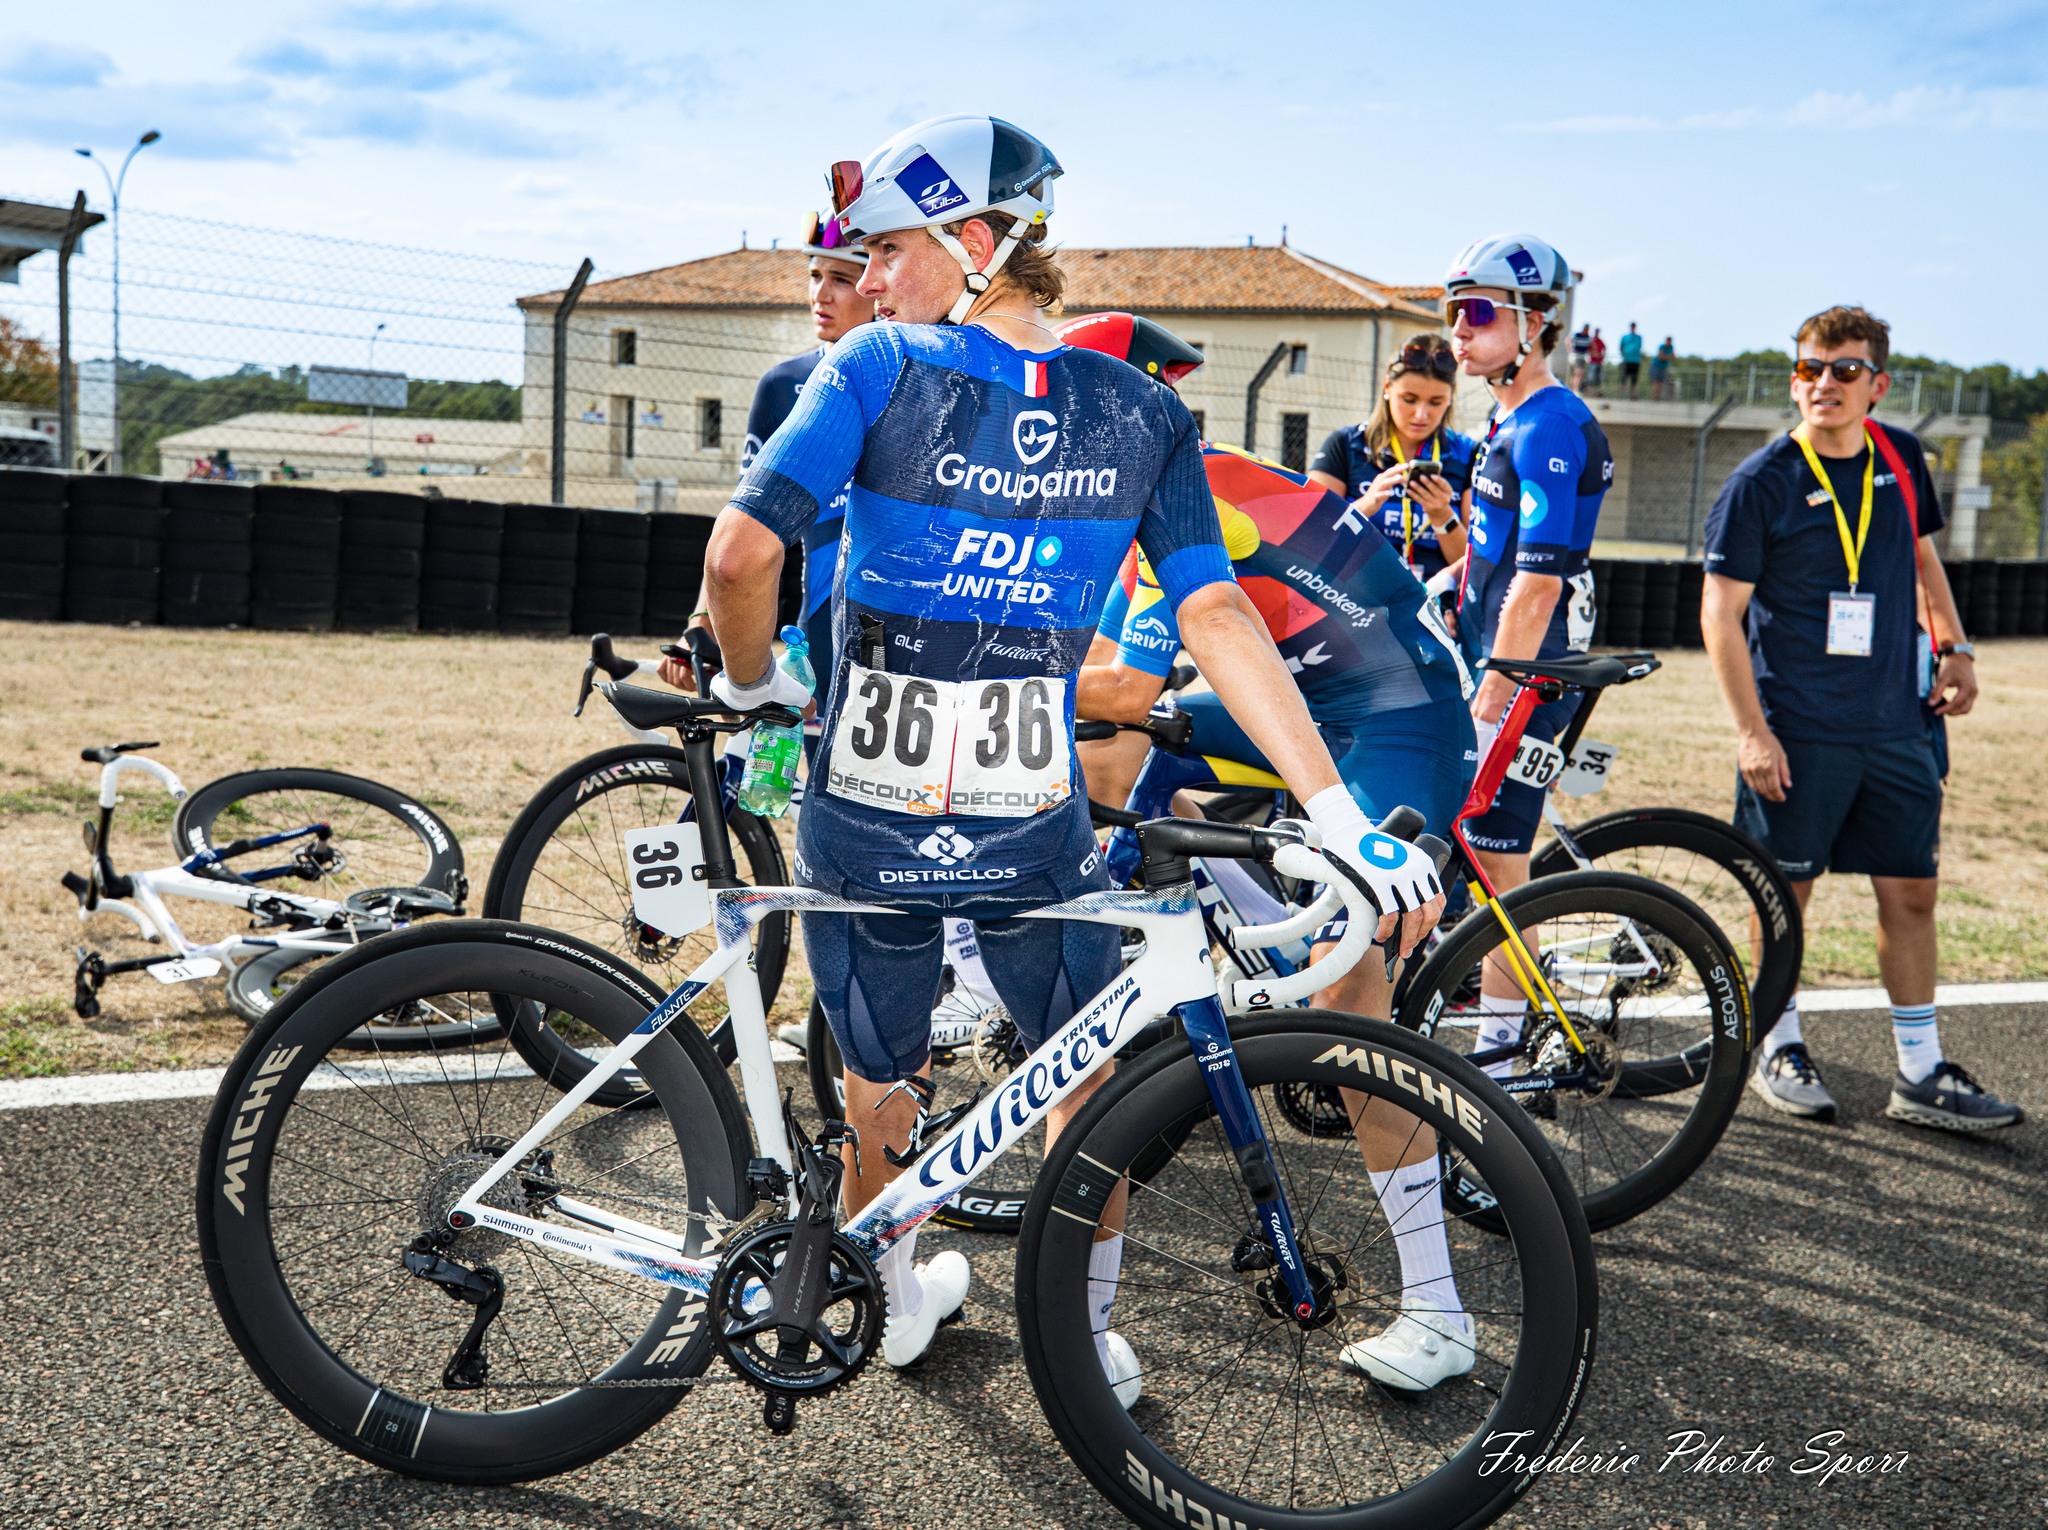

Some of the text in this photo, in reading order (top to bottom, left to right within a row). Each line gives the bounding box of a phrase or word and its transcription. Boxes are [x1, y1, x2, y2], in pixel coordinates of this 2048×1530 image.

[926, 194, 963, 213] Julbo
[935, 453, 1118, 506] Groupama
[951, 527, 1034, 577] FDJ
[941, 572, 1052, 606] UNITED
[1286, 565, 1366, 621] unbroken
[1122, 627, 1178, 653] CRIVIT
[851, 672, 939, 768] 36
[975, 679, 1054, 771] 36
[575, 760, 673, 802] MICHE
[1521, 747, 1559, 784] 95
[1579, 749, 1612, 775] 34
[829, 771, 931, 805] DÉCOUX
[909, 803, 939, 814] sport
[951, 787, 1059, 807] DÉCOUX
[400, 803, 449, 855] MICHE
[633, 840, 682, 889] 36
[879, 867, 1018, 884] DISTRICLOS
[1733, 858, 1789, 942] MICHE
[166, 966, 192, 979] 31
[534, 937, 584, 958] GRAND
[581, 954, 616, 974] PRIX
[613, 970, 651, 999] 5000
[650, 991, 692, 1031] FILANTE
[1061, 976, 1136, 1048] TRIESTINA
[1710, 965, 1739, 1040] AEOLUS
[1198, 1047, 1233, 1063] Groupama
[1208, 1061, 1223, 1073] FDJ
[919, 987, 1141, 1188] Wilier
[1312, 1043, 1483, 1145] MICHE
[1503, 1079, 1547, 1091] unbroken
[223, 1044, 303, 1217] MICHE
[1078, 1183, 1091, 1198] 62
[482, 1214, 587, 1251] SHIMANO Continental
[1271, 1211, 1295, 1270] Wilier
[793, 1244, 813, 1314] ULTEGRA
[1552, 1358, 1586, 1441] GRAND PRIX
[385, 1420, 399, 1433] 62
